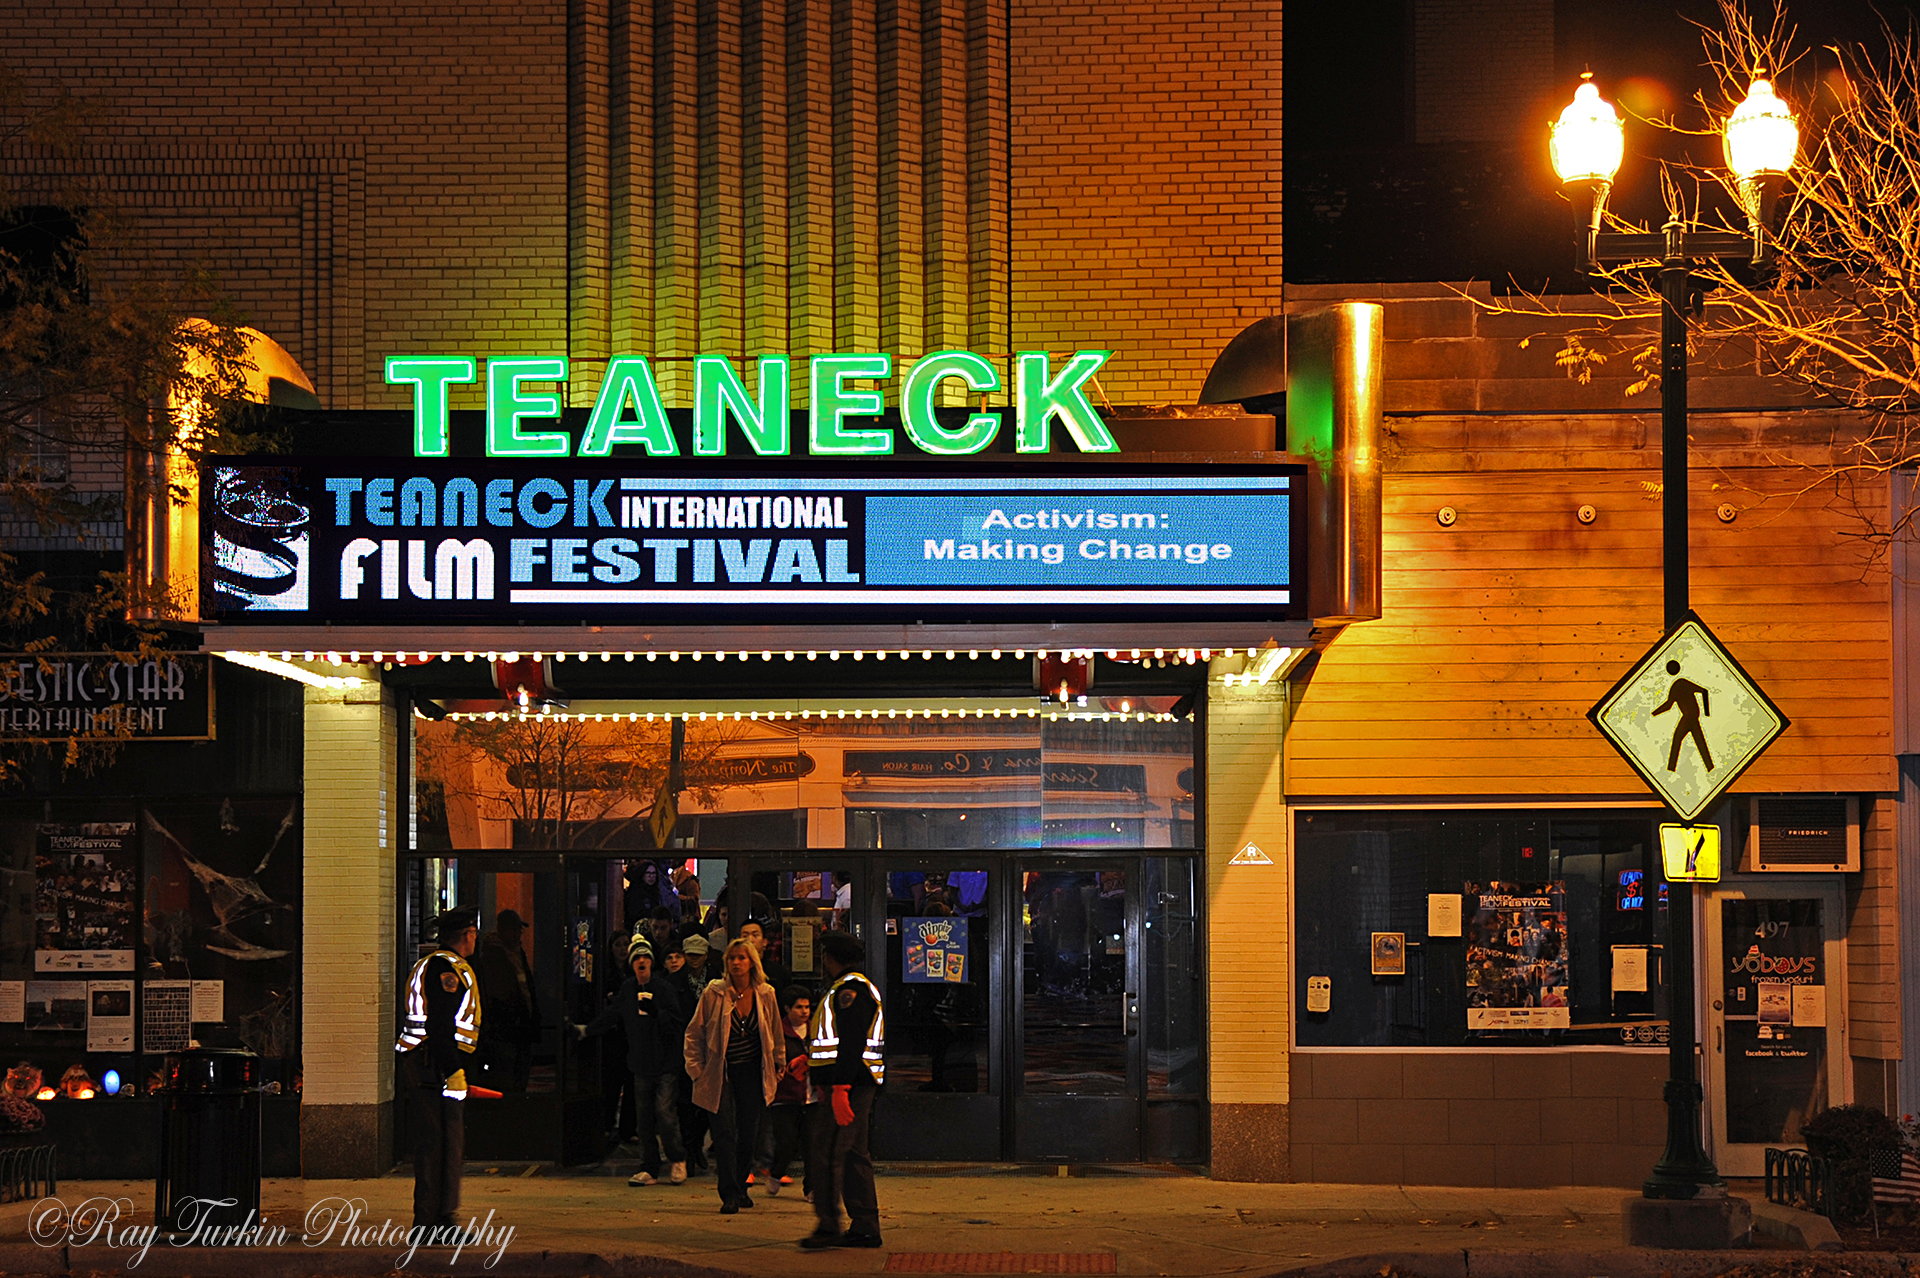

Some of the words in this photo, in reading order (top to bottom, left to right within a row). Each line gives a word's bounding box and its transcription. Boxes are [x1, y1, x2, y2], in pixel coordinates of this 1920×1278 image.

[384, 350, 1121, 457] TEANECK
[325, 477, 616, 528] TEANECK
[621, 496, 848, 529] INTERNATIONAL
[981, 508, 1169, 530] Activism:
[923, 538, 1064, 565] Making
[1078, 538, 1233, 565] Change
[340, 537, 495, 600] FILM
[510, 537, 860, 583] FESTIVAL
[73, 841, 122, 849] FESTIVAL
[1755, 921, 1790, 938] 497
[1505, 952, 1530, 963] MAKING
[1731, 953, 1816, 974] yoboys
[1751, 974, 1781, 984] frozen
[1782, 974, 1814, 986] yogurt
